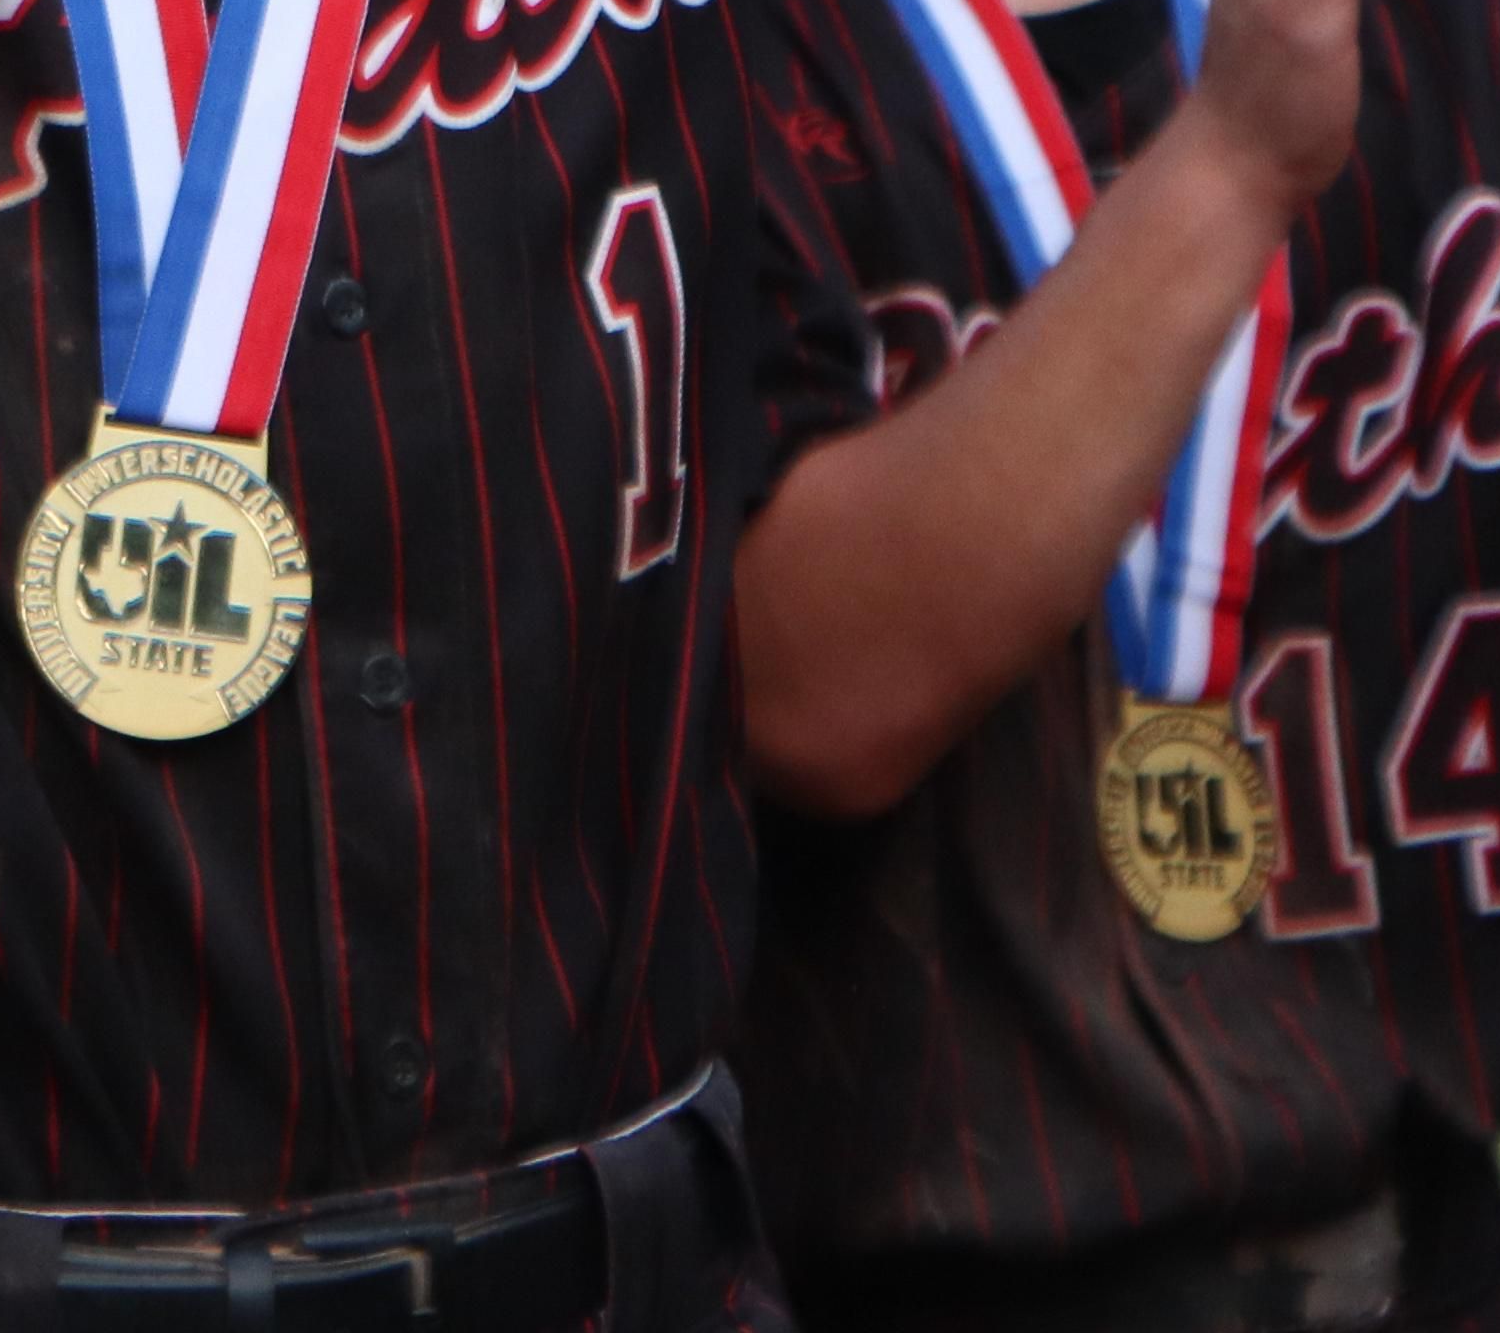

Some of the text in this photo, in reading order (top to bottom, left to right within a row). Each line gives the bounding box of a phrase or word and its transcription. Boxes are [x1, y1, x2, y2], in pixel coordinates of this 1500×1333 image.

[585, 184, 688, 582] 1
[19, 441, 312, 722] UNIVERSITY INTERSCHOLASTIC LEAGUE
[76, 499, 252, 644] UIL
[100, 631, 215, 678] STATE
